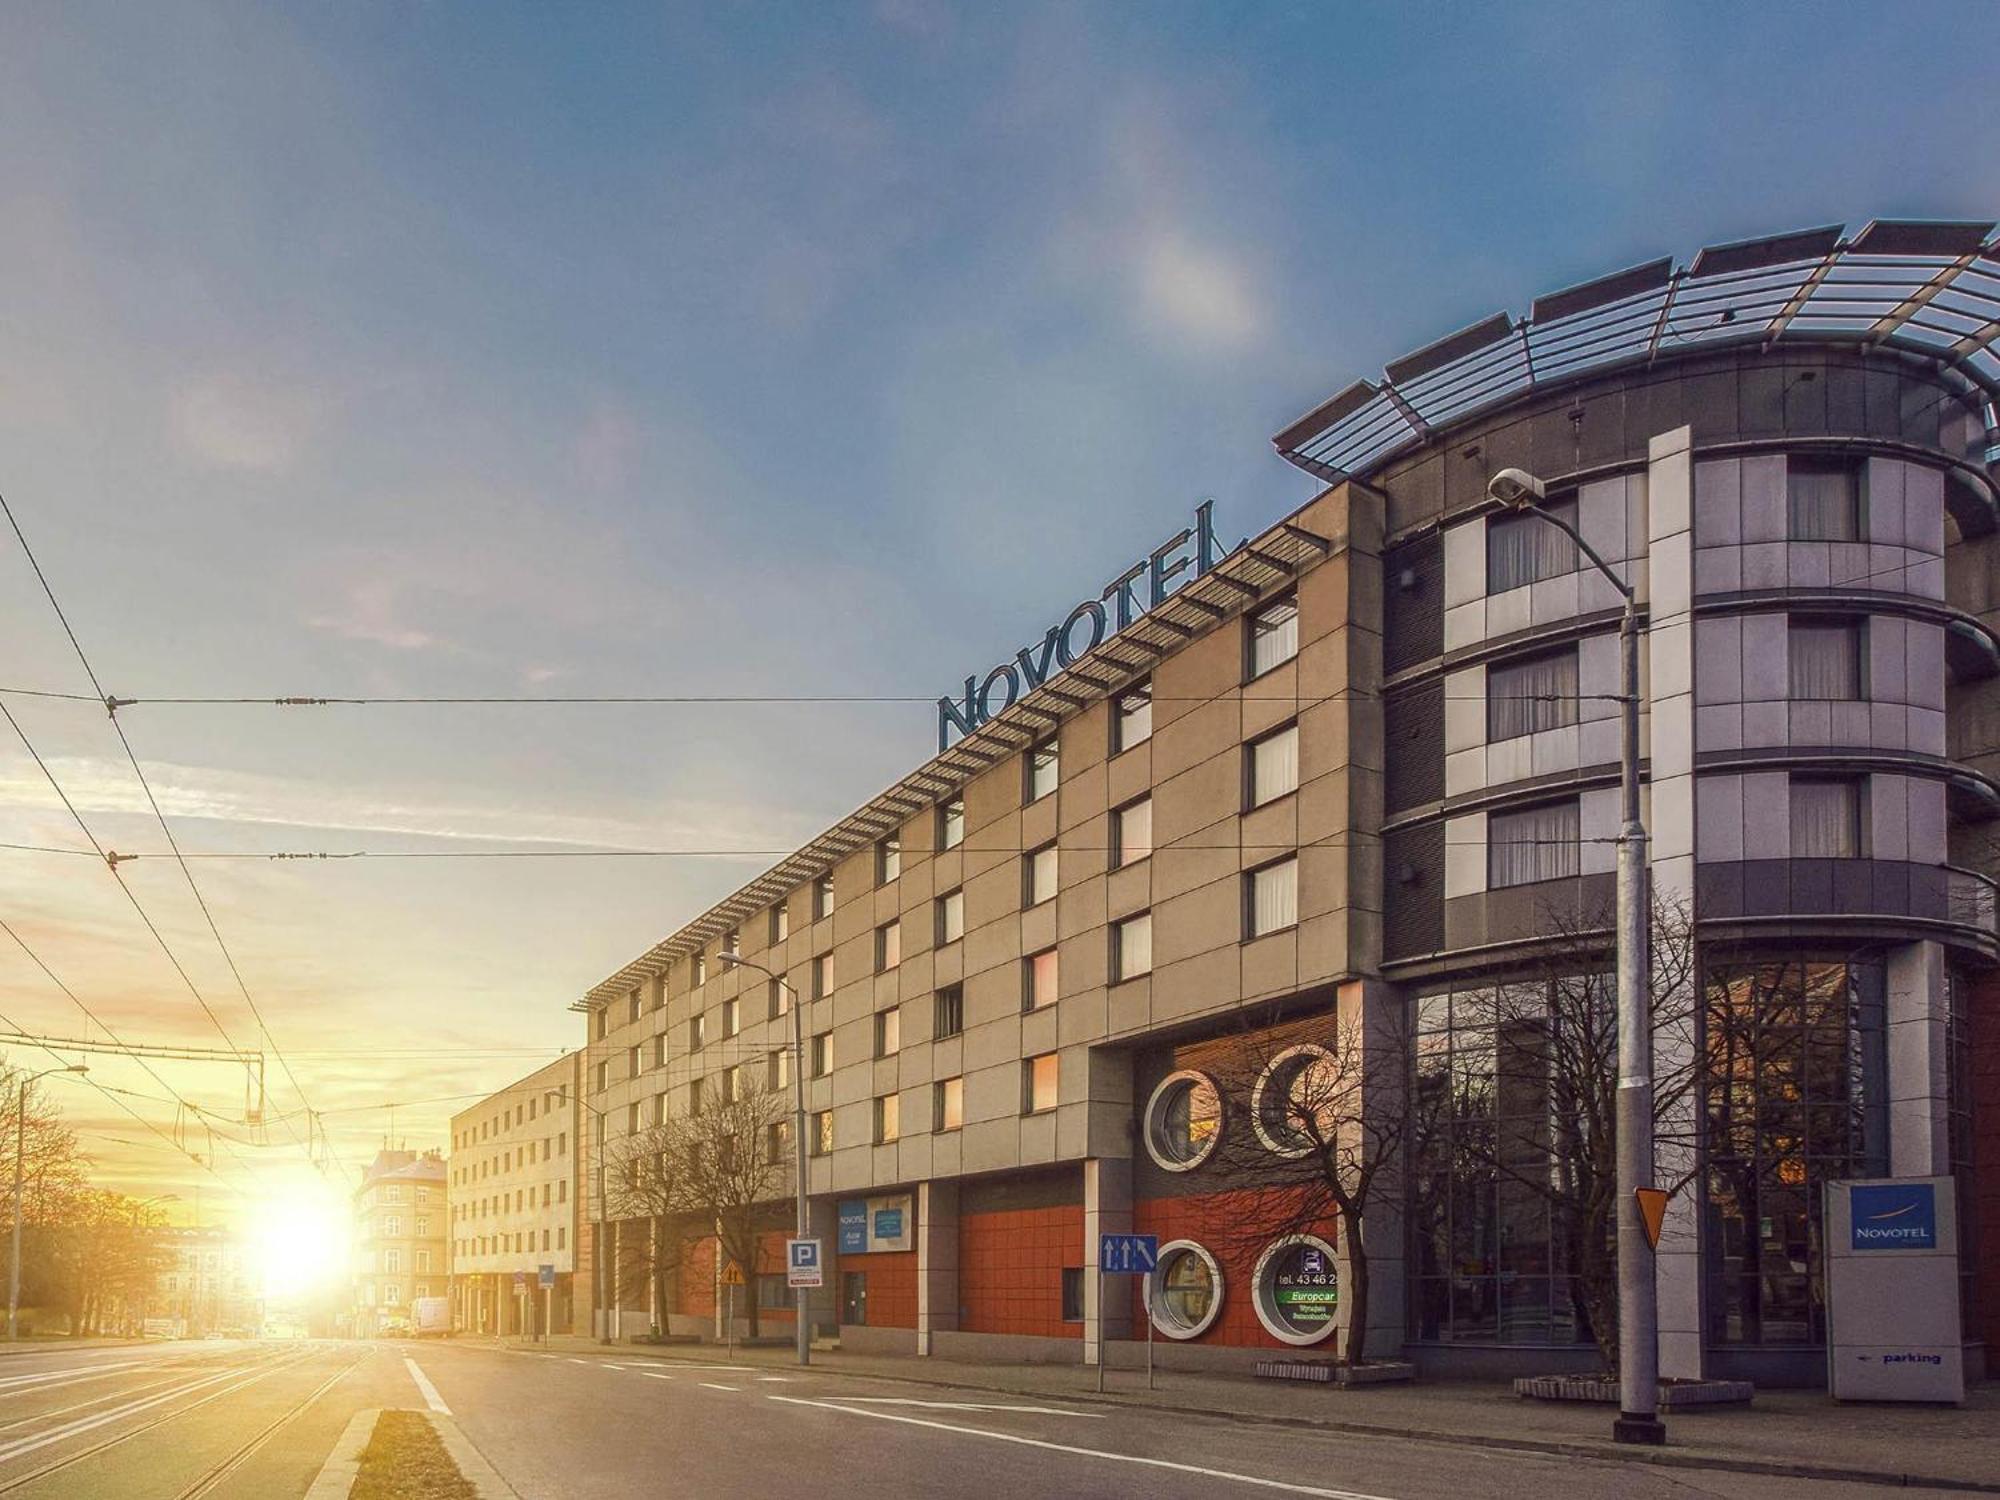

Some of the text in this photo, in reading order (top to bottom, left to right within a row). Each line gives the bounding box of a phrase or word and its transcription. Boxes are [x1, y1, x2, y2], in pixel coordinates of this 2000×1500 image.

[937, 499, 1248, 754] NOVOTEL
[1857, 1227, 1929, 1238] NOVOTEL
[797, 1246, 812, 1265] P
[1292, 1291, 1336, 1303] Europcar
[1883, 1353, 1942, 1365] parking
